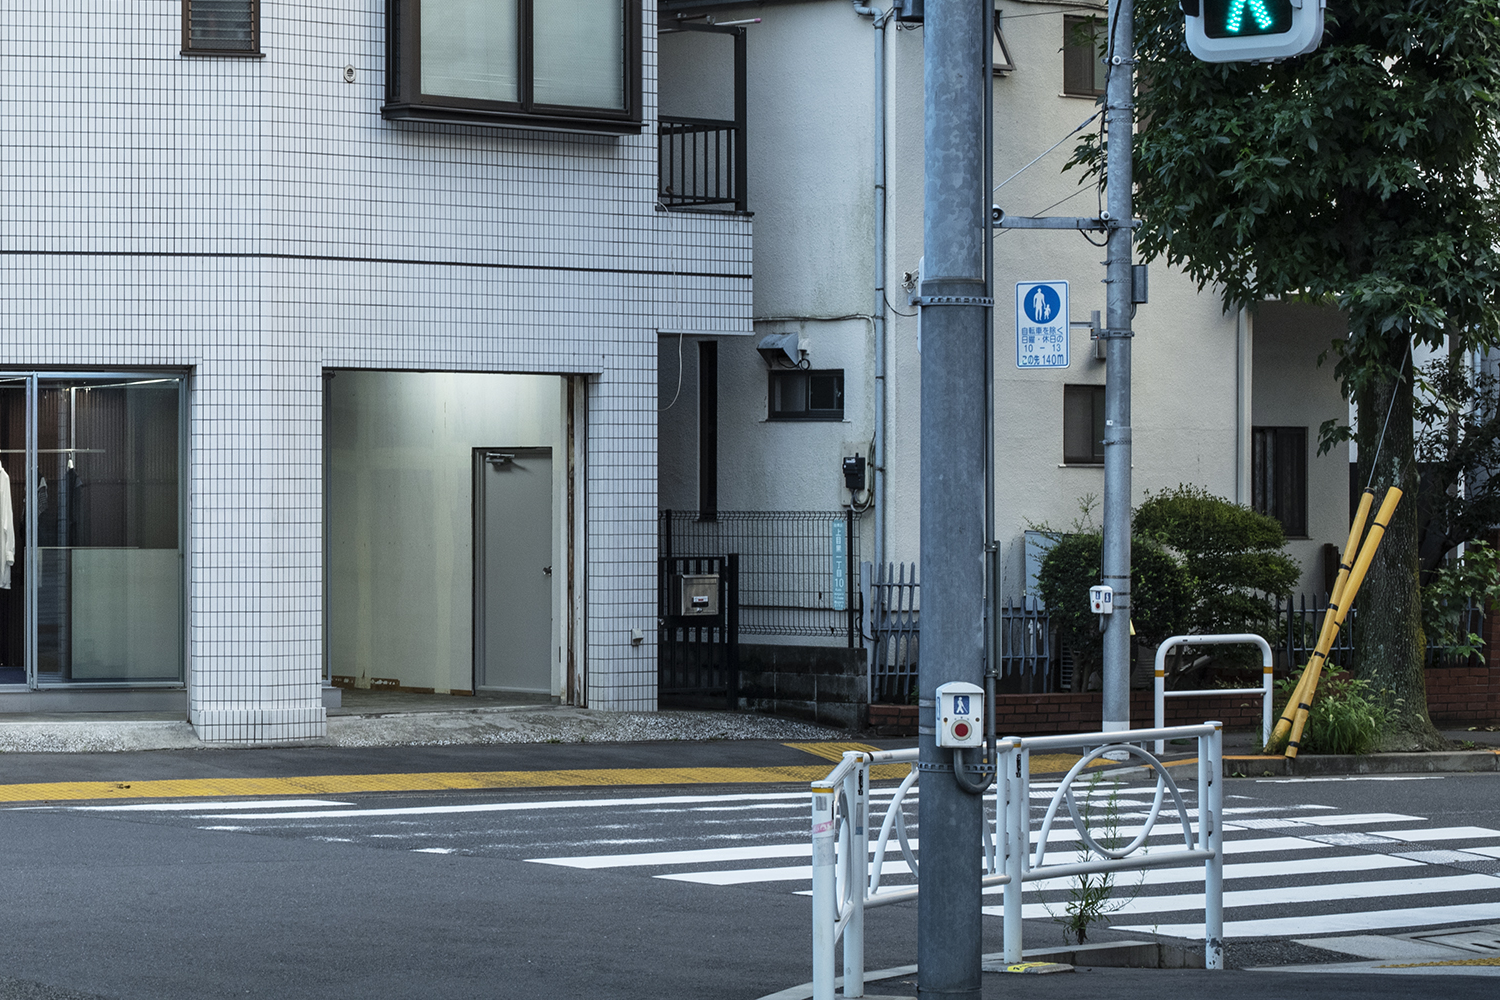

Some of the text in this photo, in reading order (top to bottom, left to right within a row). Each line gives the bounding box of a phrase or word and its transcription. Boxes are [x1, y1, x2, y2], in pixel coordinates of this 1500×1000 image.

[1021, 326, 1063, 335] 自転車を除く
[1021, 335, 1064, 344] 日曜・休日の
[1024, 344, 1033, 352] 10
[1052, 344, 1061, 352] 13
